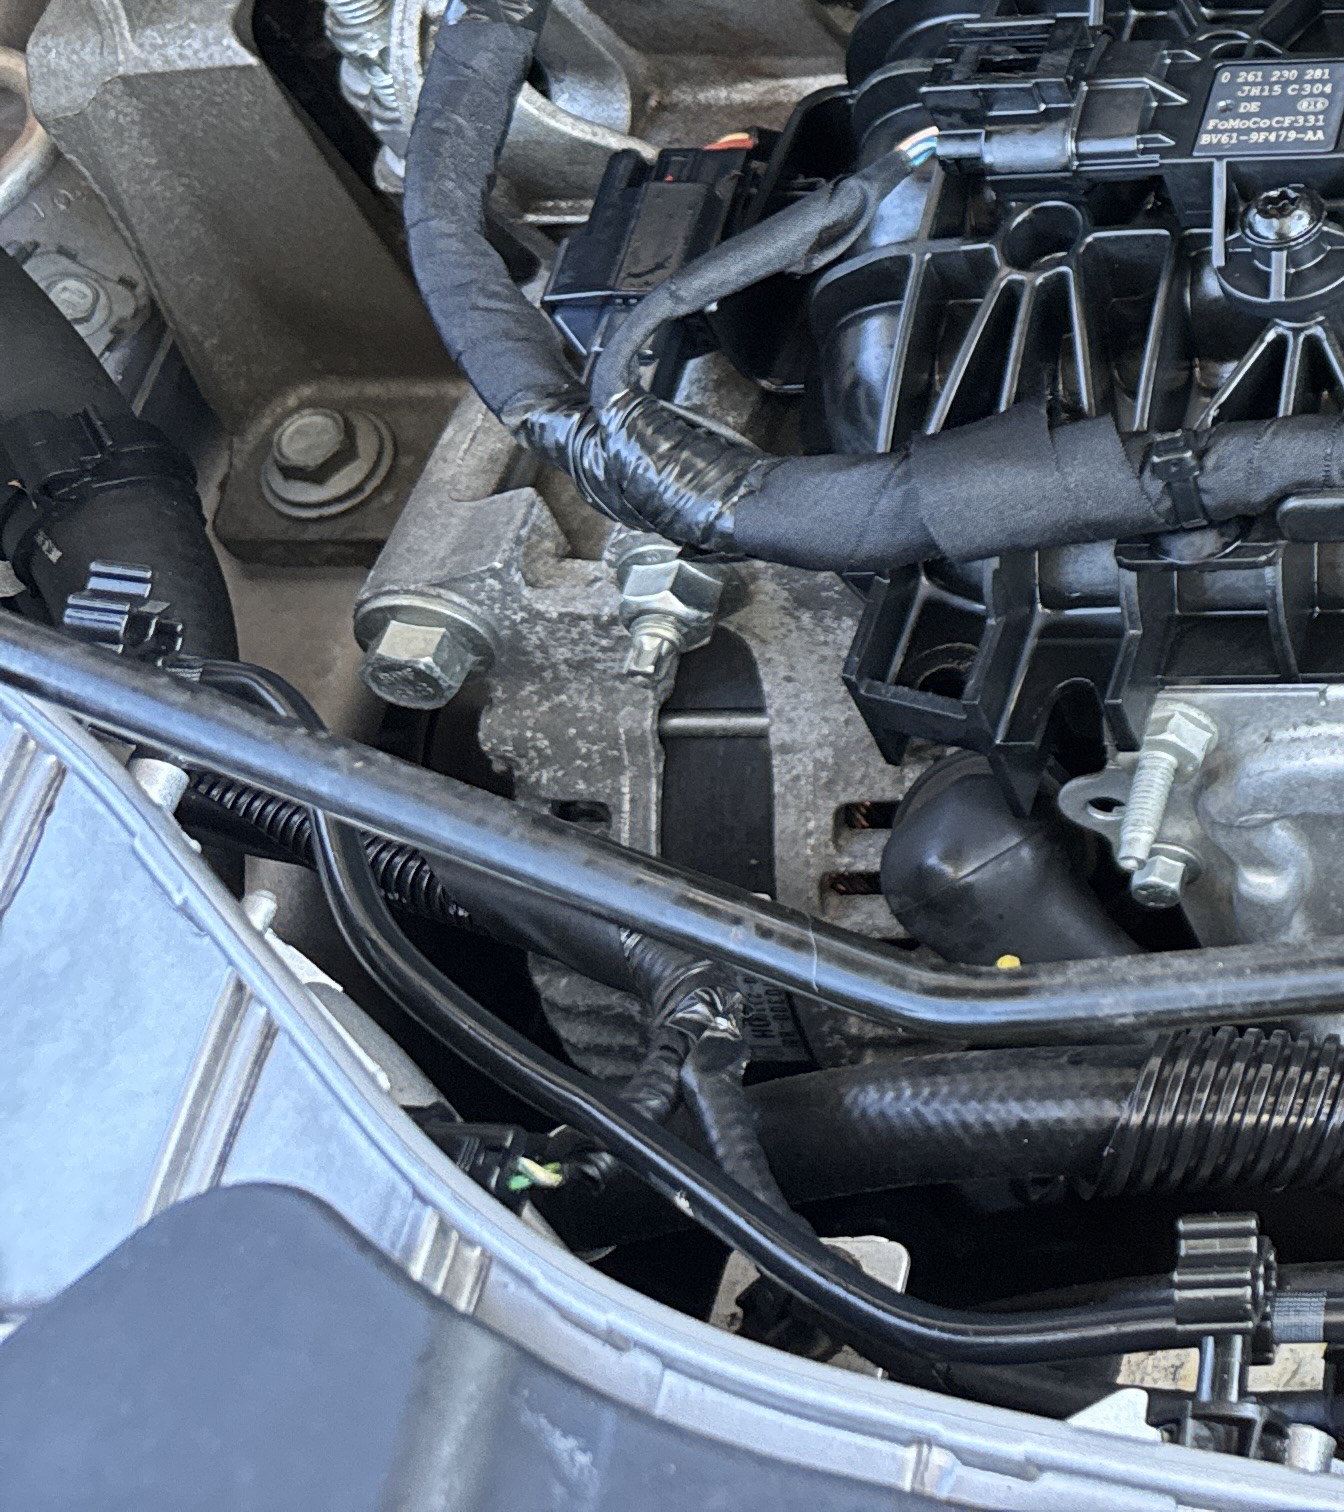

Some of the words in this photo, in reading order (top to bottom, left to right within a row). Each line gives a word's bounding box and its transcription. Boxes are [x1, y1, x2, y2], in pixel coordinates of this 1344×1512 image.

[1221, 72, 1231, 83] 0
[1236, 71, 1264, 83] 261
[1270, 69, 1299, 82] 230
[1303, 68, 1331, 81] 281
[1238, 101, 1262, 113] DE
[1199, 129, 1325, 145] BV61-9F479-AA
